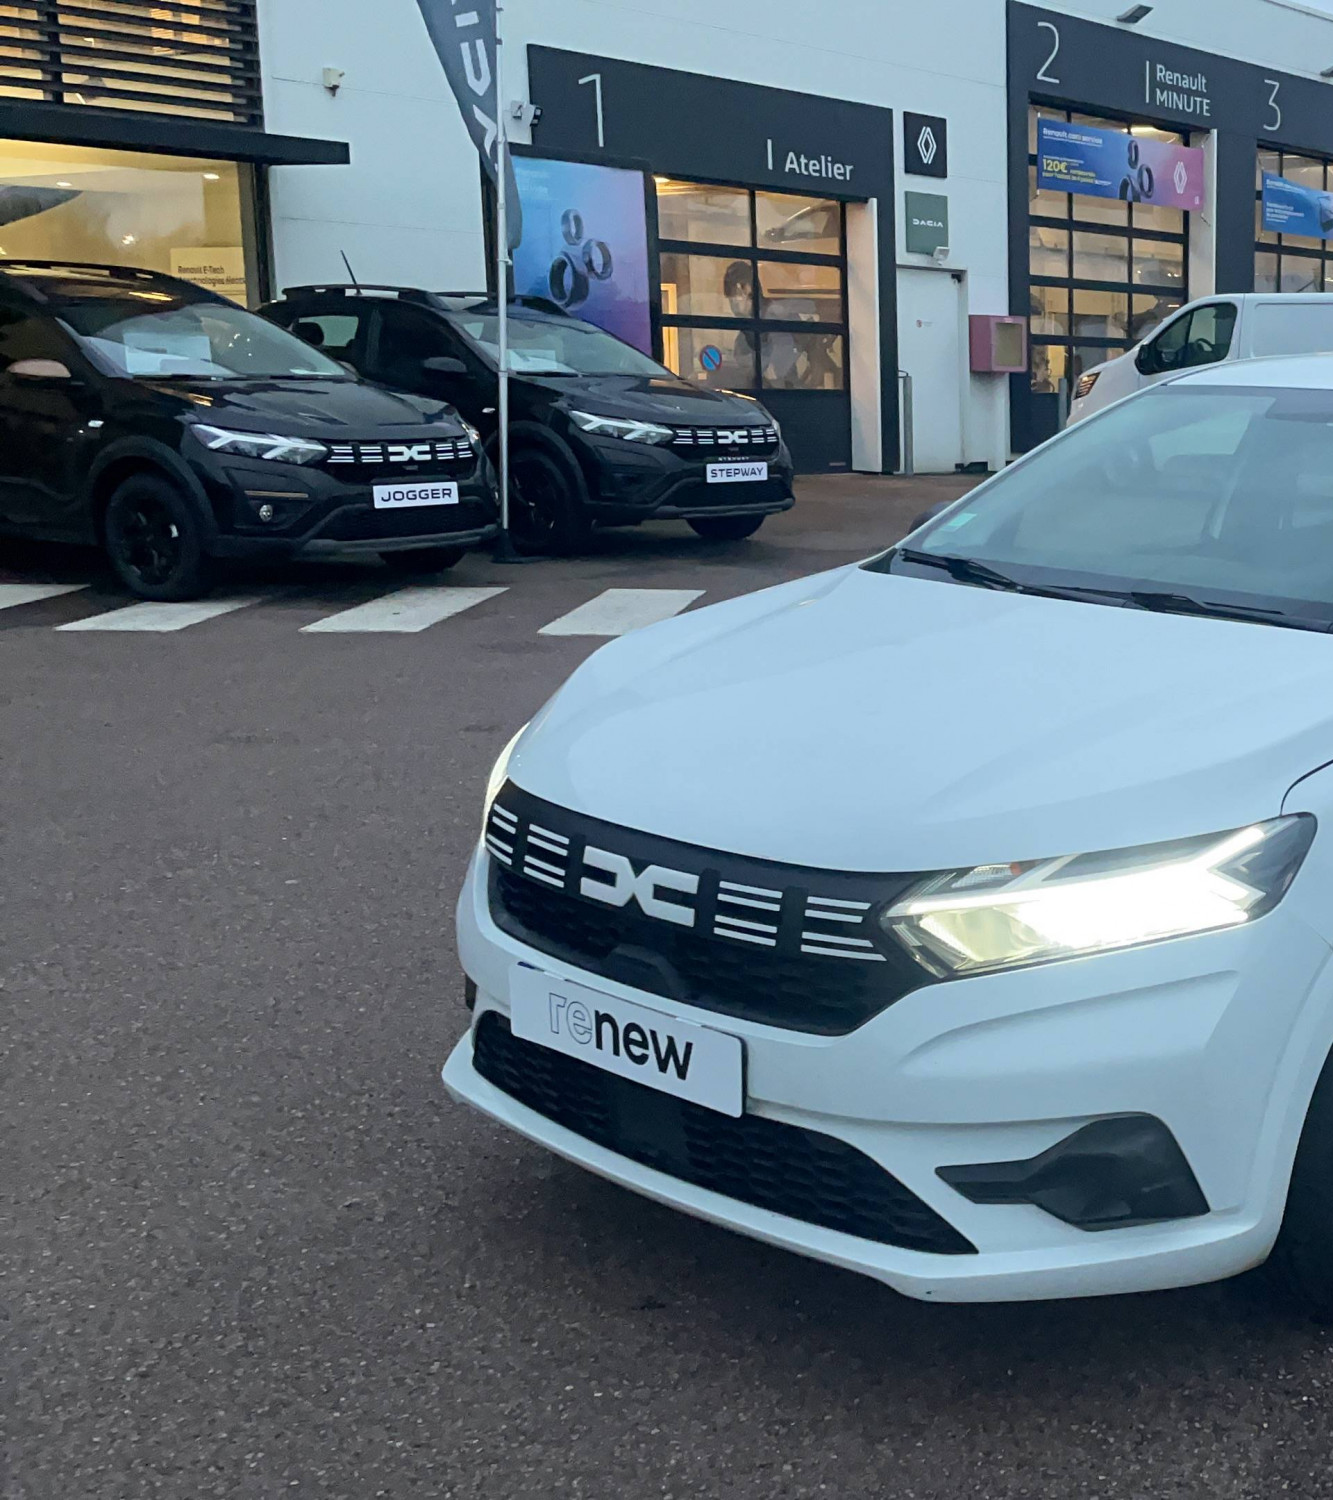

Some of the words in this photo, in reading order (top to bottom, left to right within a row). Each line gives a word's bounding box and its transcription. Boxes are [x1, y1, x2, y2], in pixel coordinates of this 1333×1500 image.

[1036, 21, 1060, 84] 2
[1156, 63, 1208, 93] Renault
[578, 73, 605, 147] 1
[1155, 87, 1212, 117] MINUTE
[1263, 79, 1281, 131] 3
[784, 151, 854, 181] Atelier
[1042, 158, 1068, 173] 120€
[912, 218, 944, 228] DACIA
[710, 467, 764, 478] STEPWAY
[381, 488, 452, 502] JOGGER
[549, 992, 694, 1081] renew
